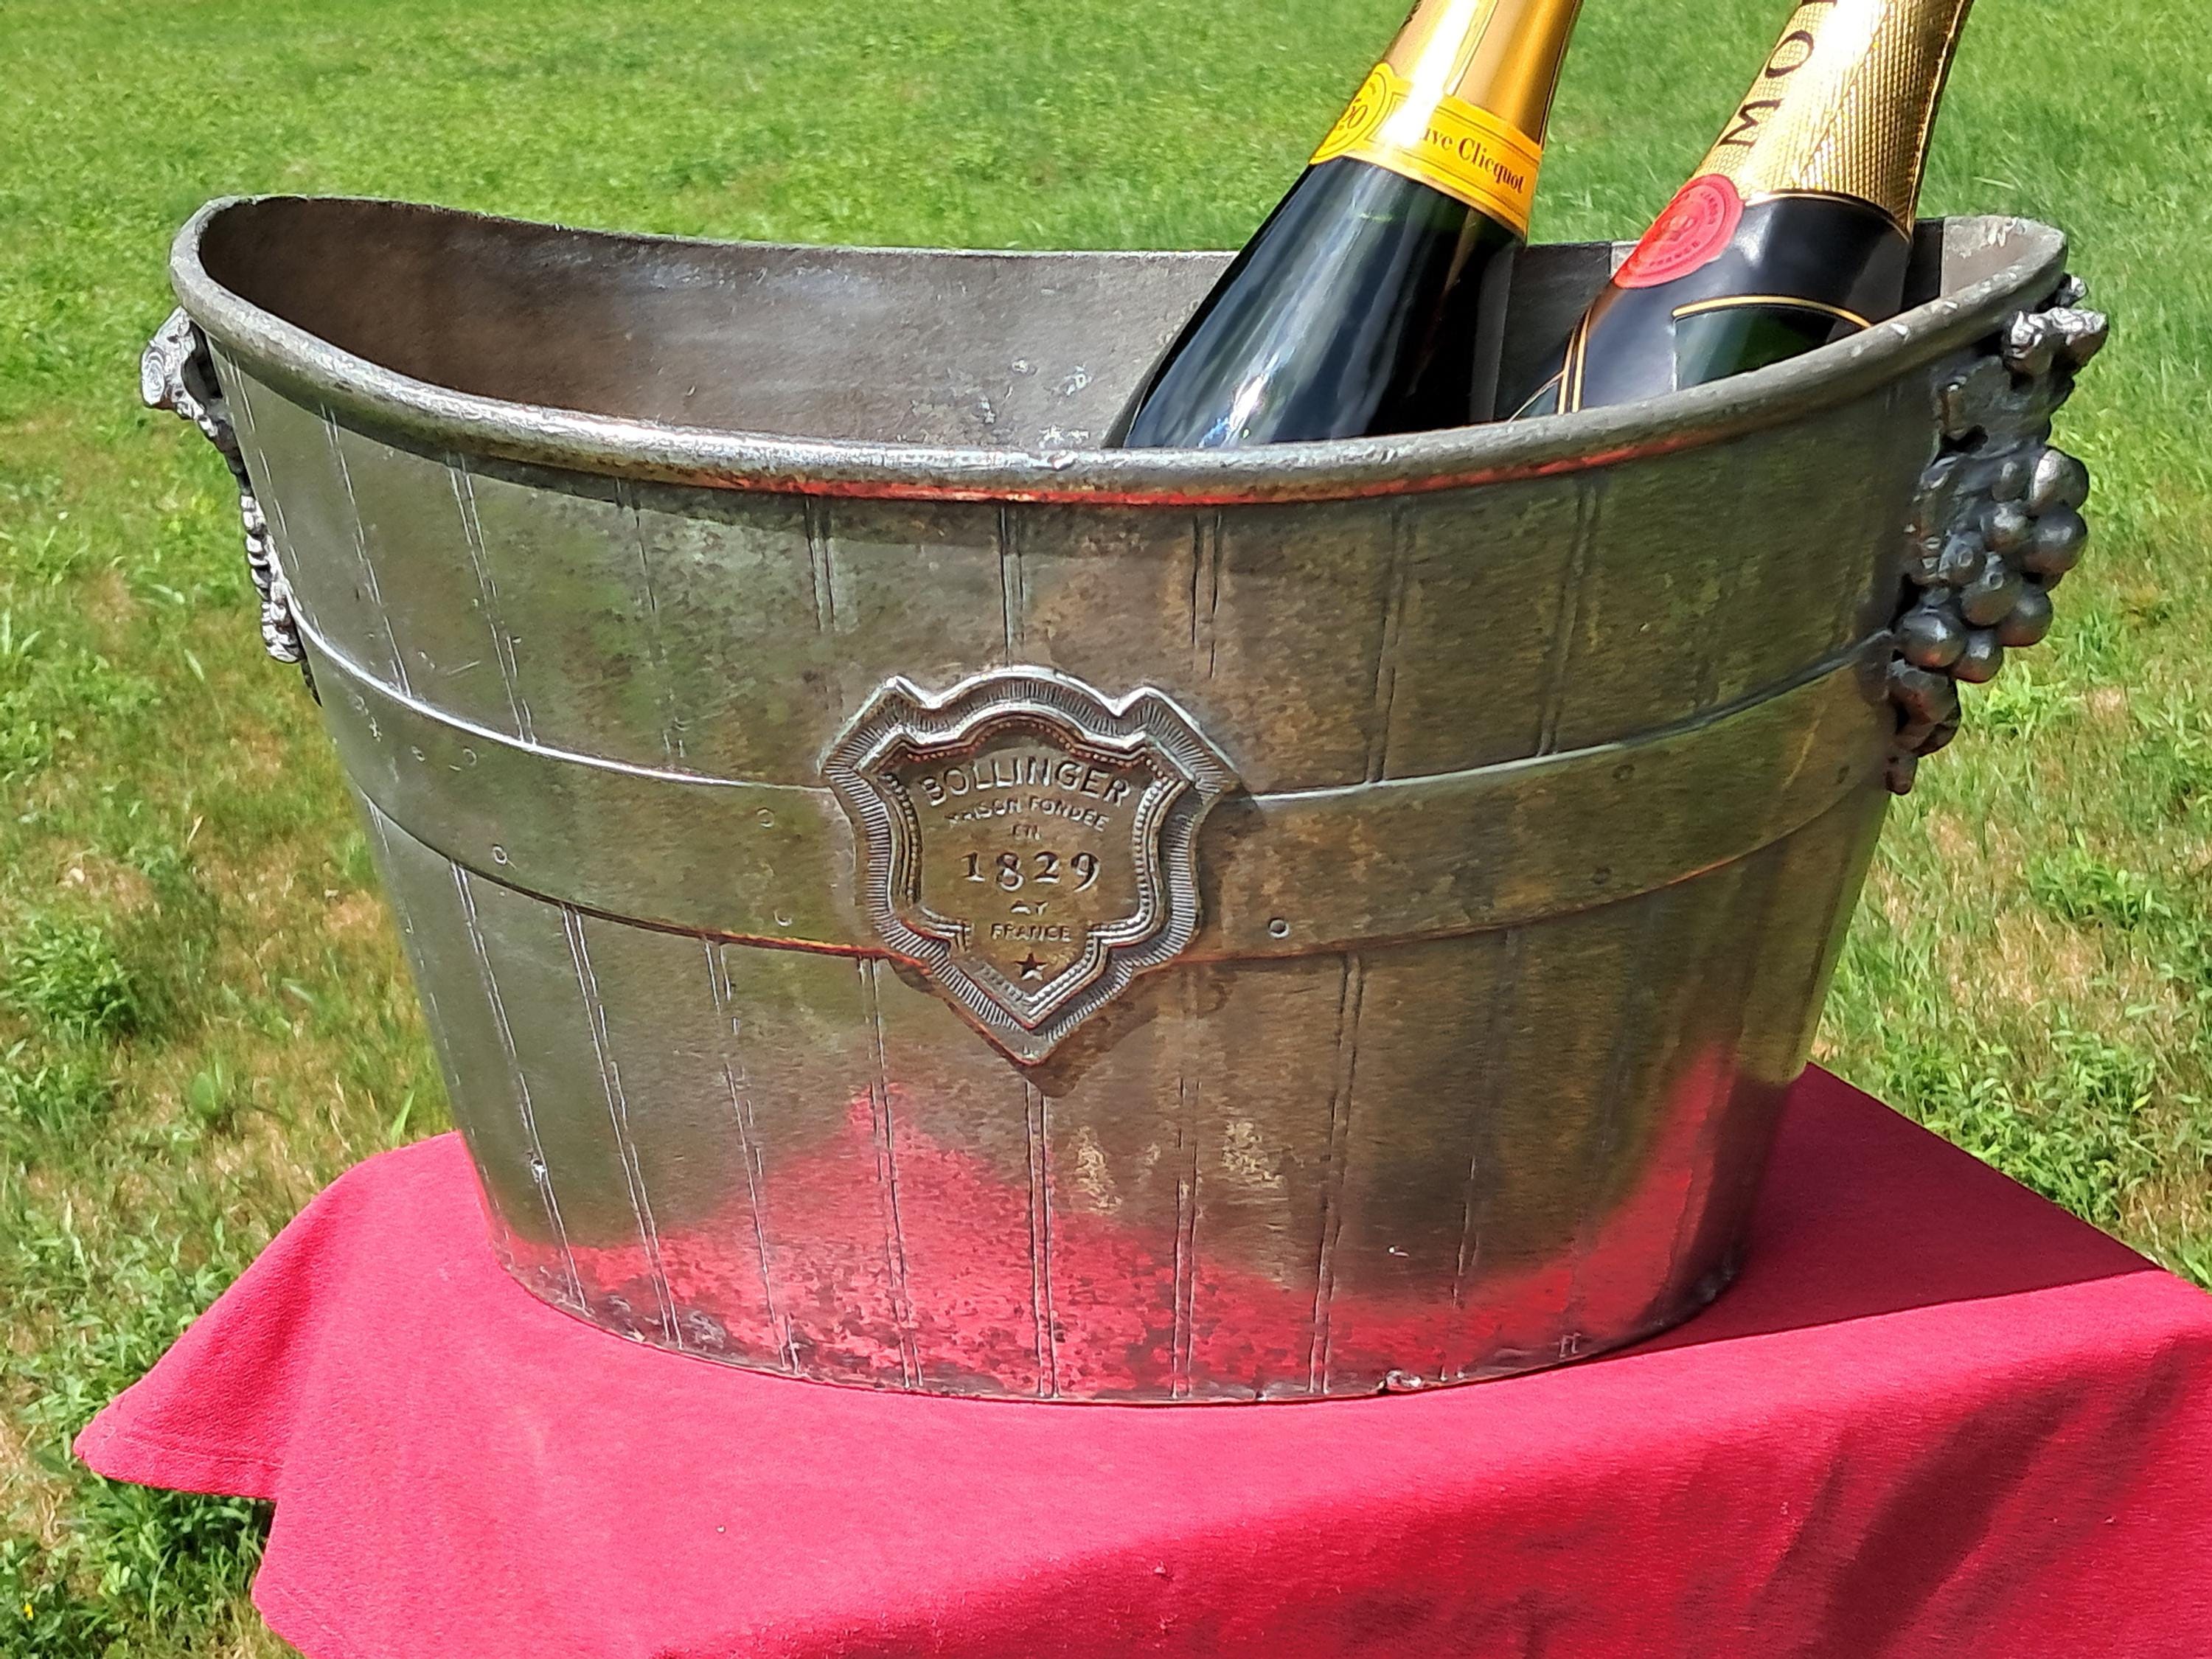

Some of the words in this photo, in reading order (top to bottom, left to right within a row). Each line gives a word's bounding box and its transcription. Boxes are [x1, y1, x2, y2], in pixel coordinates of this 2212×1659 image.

[1458, 137, 1525, 195] Clicquot
[919, 756, 1132, 808] BOLLINGER
[961, 850, 1101, 894] 1829
[991, 922, 1072, 944] FRANCE
